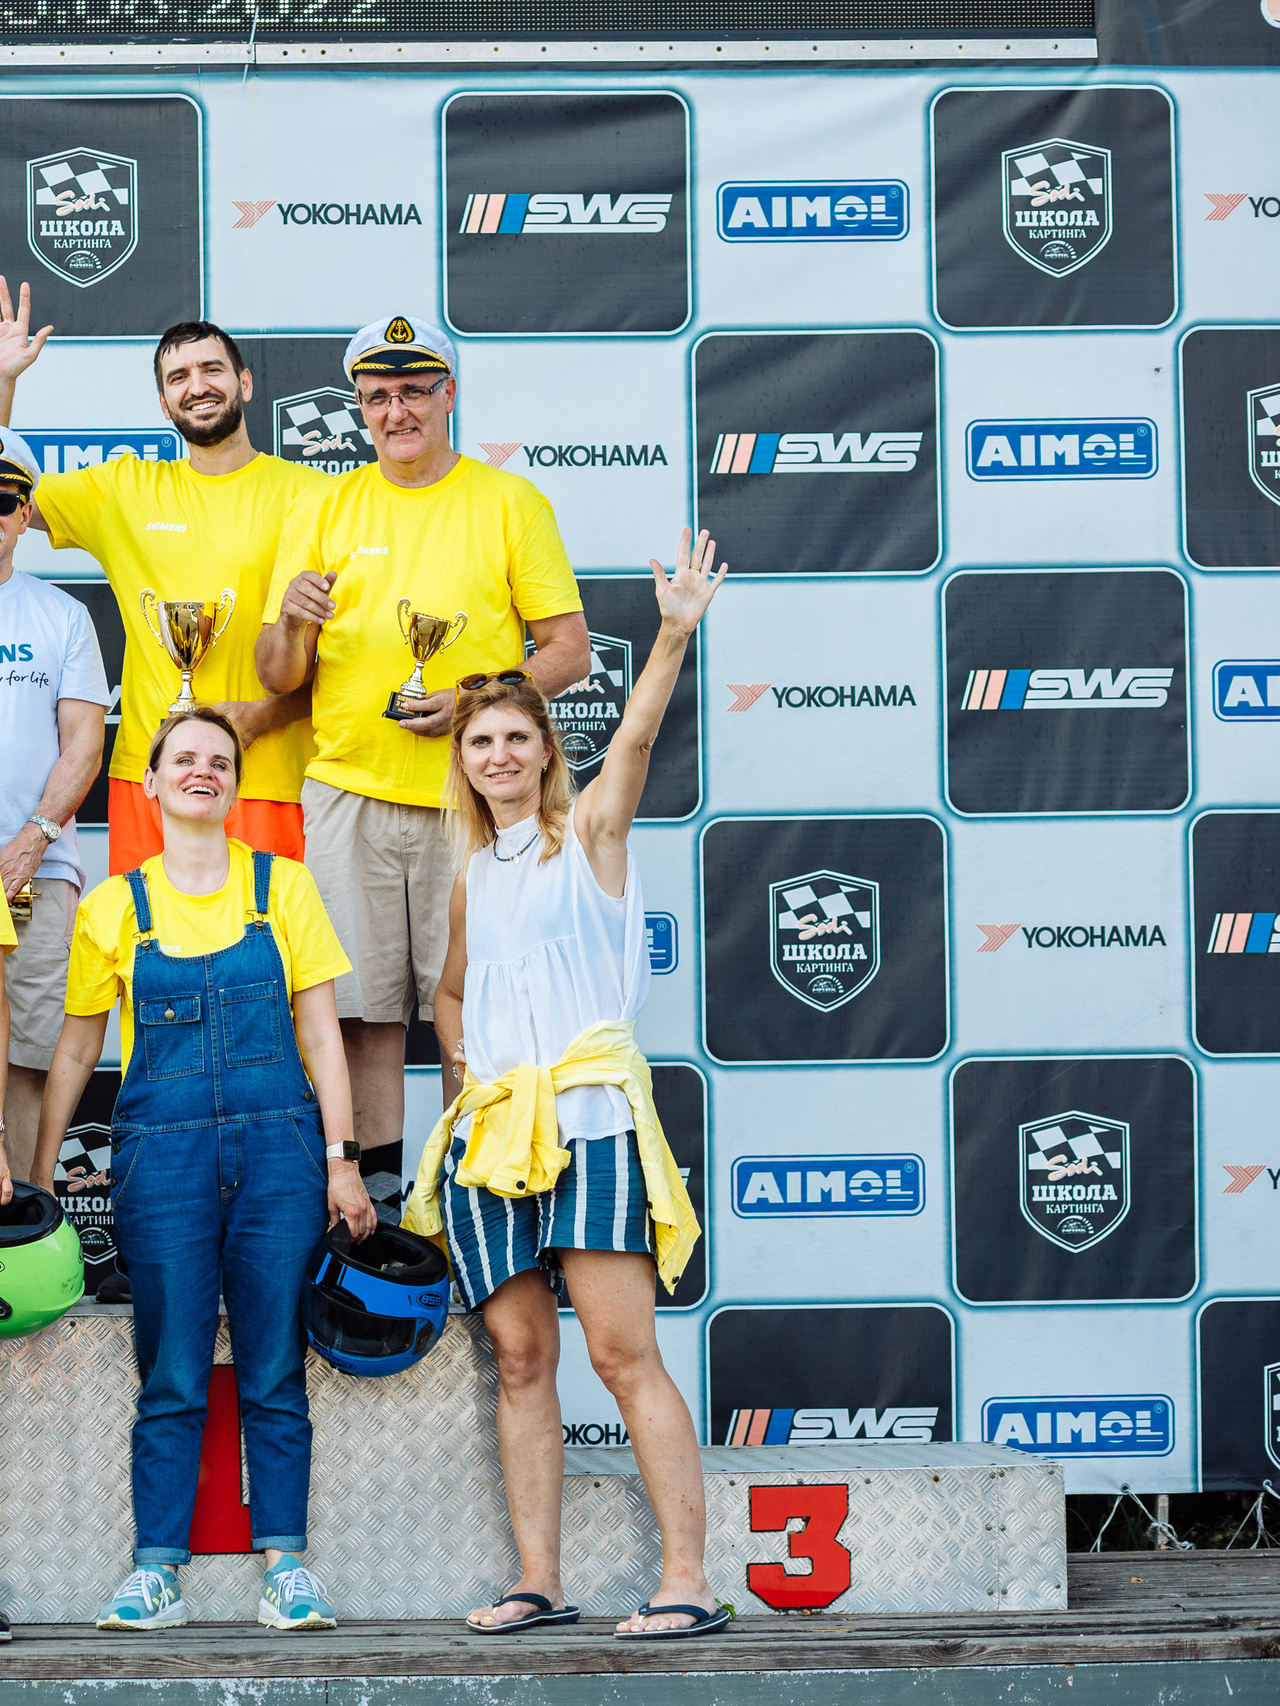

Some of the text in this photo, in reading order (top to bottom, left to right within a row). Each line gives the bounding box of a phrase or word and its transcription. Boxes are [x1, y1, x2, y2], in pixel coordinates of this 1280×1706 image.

[55, 190, 111, 216] Sodi
[1030, 180, 1085, 207] Sodi
[277, 203, 423, 226] YOKOHAMA
[522, 193, 673, 233] SWS
[1015, 210, 1099, 226] ШКОЛА
[40, 220, 125, 236] ШКОЛА
[1029, 229, 1087, 238] КАРТИНГА
[53, 239, 112, 248] КАРТИНГА
[301, 430, 357, 456] Sodi
[773, 431, 924, 473] SWS
[522, 444, 669, 467] YOKOHAMA
[6, 670, 30, 686] for
[30, 671, 50, 689] life
[1022, 667, 1175, 709] SWS
[771, 684, 917, 709] YOKOHAMA
[798, 914, 853, 940] Sodi
[1022, 924, 1167, 948] YOKOHAMA
[782, 944, 868, 960] ШКОЛА
[796, 963, 855, 973] КАРТИНГА
[1047, 1154, 1103, 1181] Sodi
[1032, 1184, 1118, 1201] ШКОЛА
[1046, 1204, 1105, 1213] КАРТИНГА
[788, 1406, 939, 1445] SWS
[747, 1483, 852, 1609] 3
